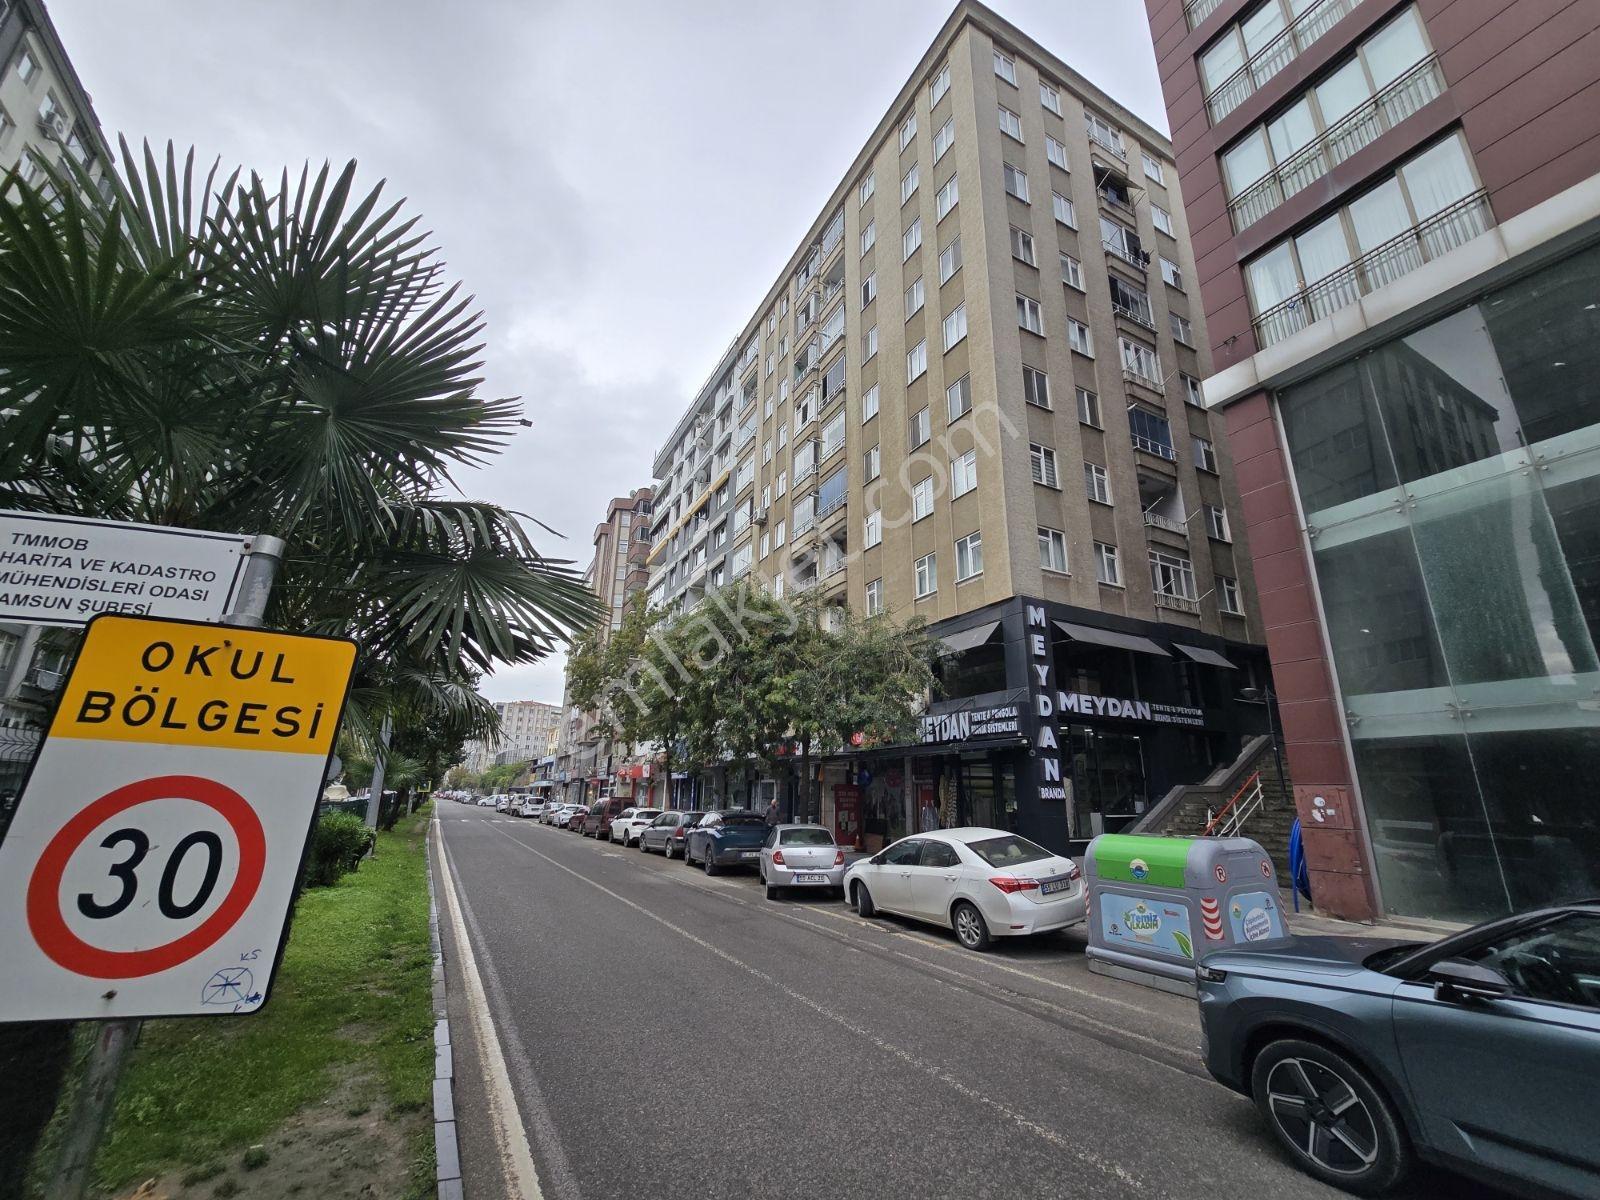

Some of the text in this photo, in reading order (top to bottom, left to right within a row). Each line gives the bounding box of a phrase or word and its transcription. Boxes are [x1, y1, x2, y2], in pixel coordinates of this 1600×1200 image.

[11, 532, 90, 551] TMMOB
[0, 550, 217, 583] HARİTA VE KADASTRO
[77, 598, 153, 615] ŞUBESİ
[149, 585, 210, 602] ODASI
[141, 641, 295, 684] OKUL
[1026, 604, 1060, 782] MEYDAN
[1057, 691, 1151, 721] MEYDAN
[76, 685, 324, 739] BÖLGESİ
[1039, 786, 1067, 800] BRANDA
[77, 828, 223, 920] 30
